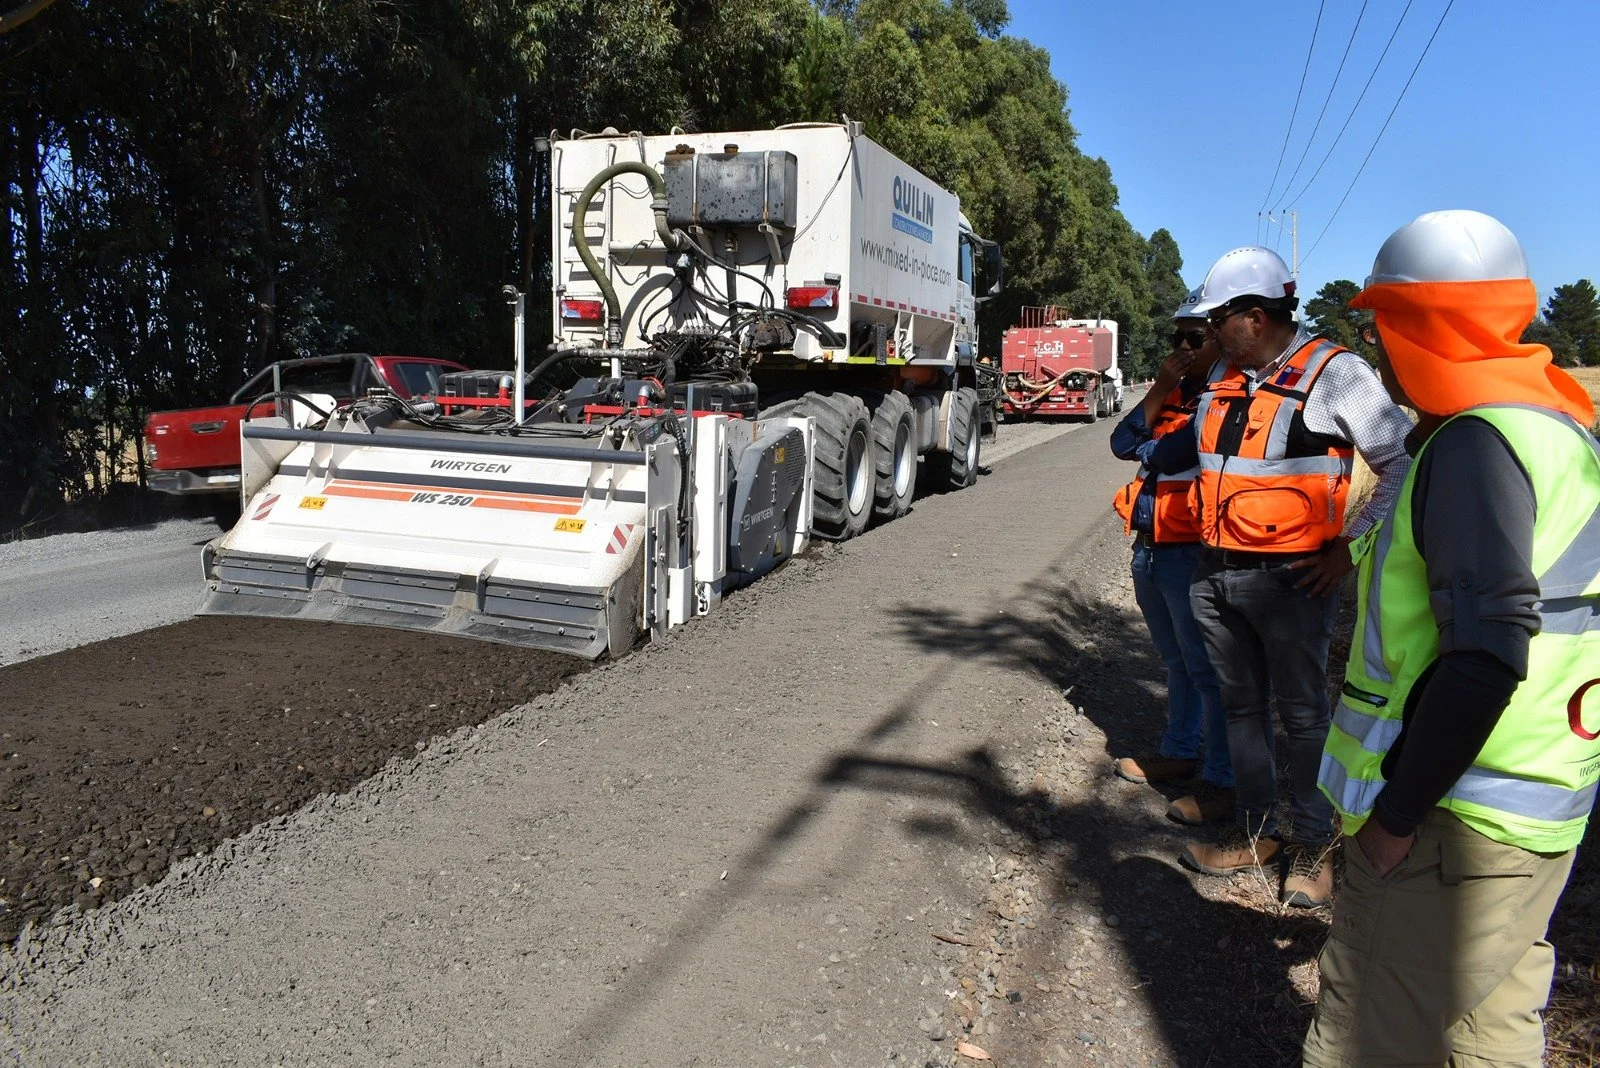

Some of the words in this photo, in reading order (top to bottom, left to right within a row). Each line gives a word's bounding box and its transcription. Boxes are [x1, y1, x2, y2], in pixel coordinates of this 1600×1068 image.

[893, 175, 934, 227] QUILIN
[860, 237, 952, 287] www.mixed-in-place.com
[430, 459, 512, 474] WIRTGEN
[411, 492, 441, 504] WS
[438, 494, 474, 507] 250
[750, 506, 774, 525] WIRTGEN
